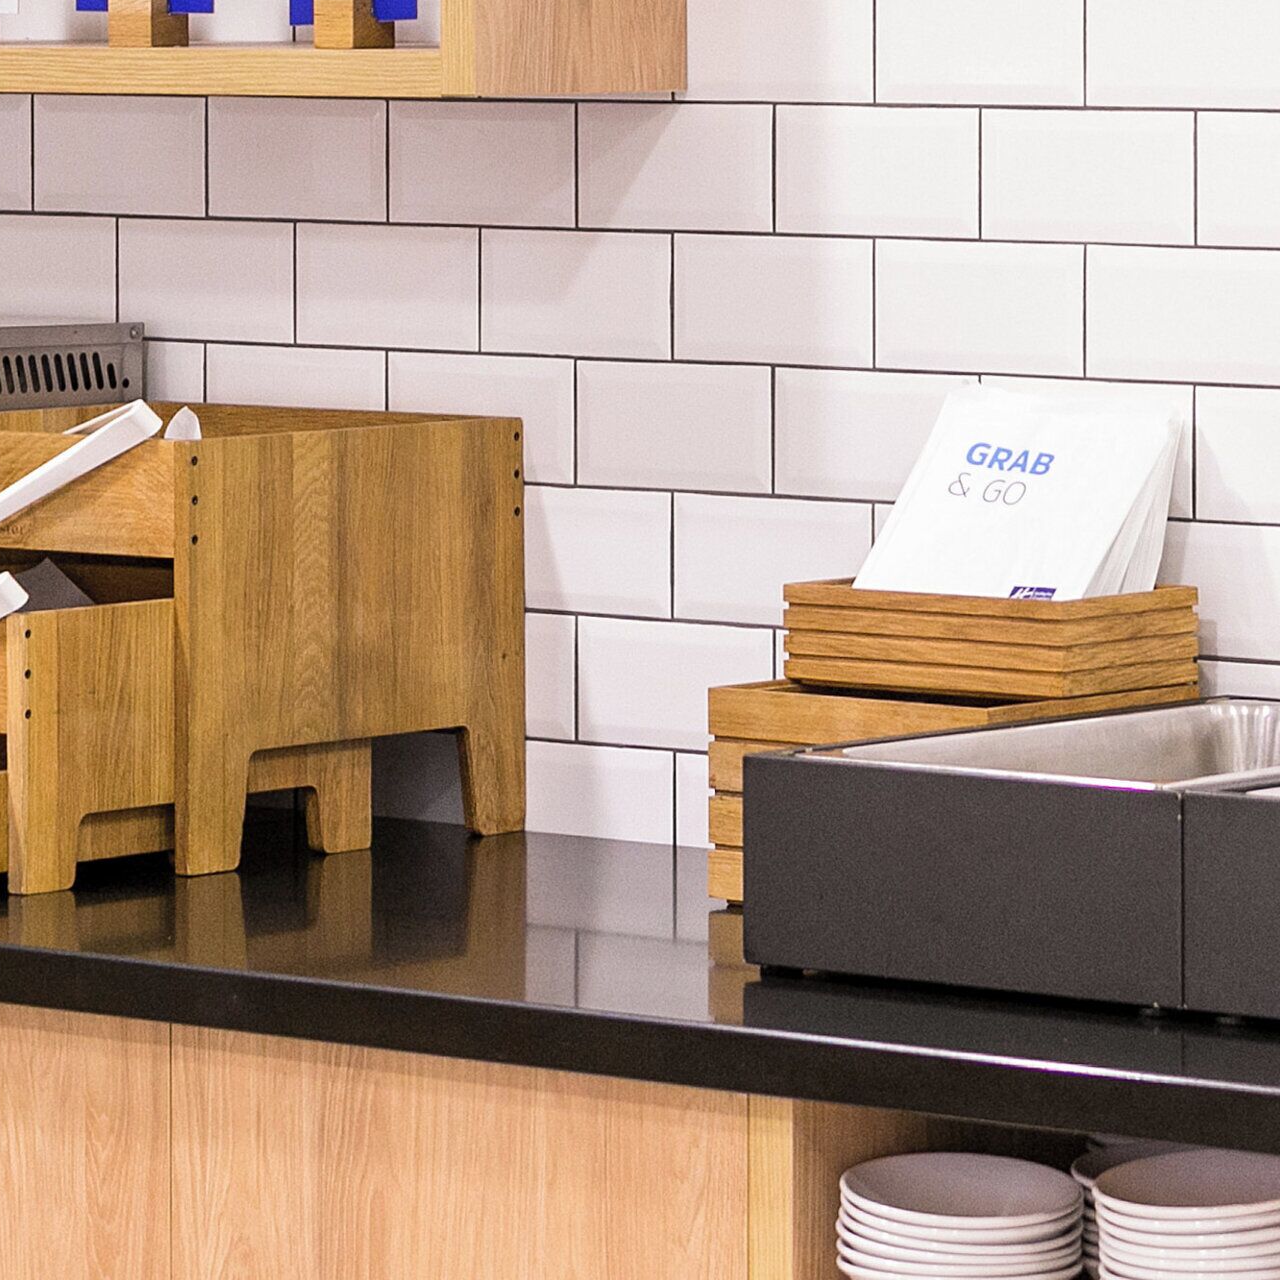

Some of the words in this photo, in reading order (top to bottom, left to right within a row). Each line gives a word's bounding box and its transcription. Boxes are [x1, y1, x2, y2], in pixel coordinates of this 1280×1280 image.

[966, 442, 1055, 475] GRAB
[948, 472, 972, 498] &
[983, 479, 1027, 505] GO
